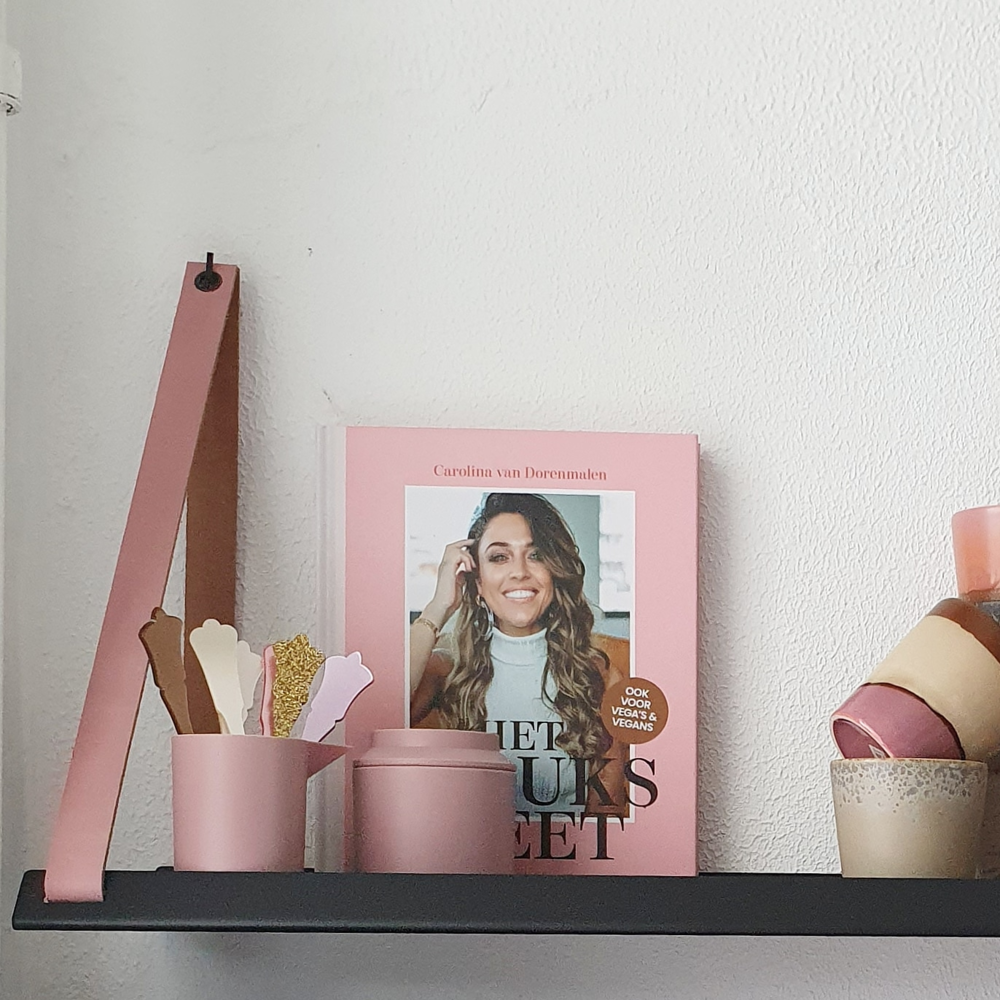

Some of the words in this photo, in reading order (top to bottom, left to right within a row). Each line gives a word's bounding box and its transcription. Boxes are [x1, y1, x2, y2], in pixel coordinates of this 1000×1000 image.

[433, 464, 492, 478] Carolina
[496, 468, 521, 479] van
[525, 466, 607, 480] Dorenmalen
[625, 686, 650, 698] OOK
[620, 696, 652, 710] VOOR
[611, 705, 647, 720] VEGA'S
[648, 712, 657, 722] &
[611, 716, 654, 732] VEGANS
[517, 756, 658, 808] UKS
